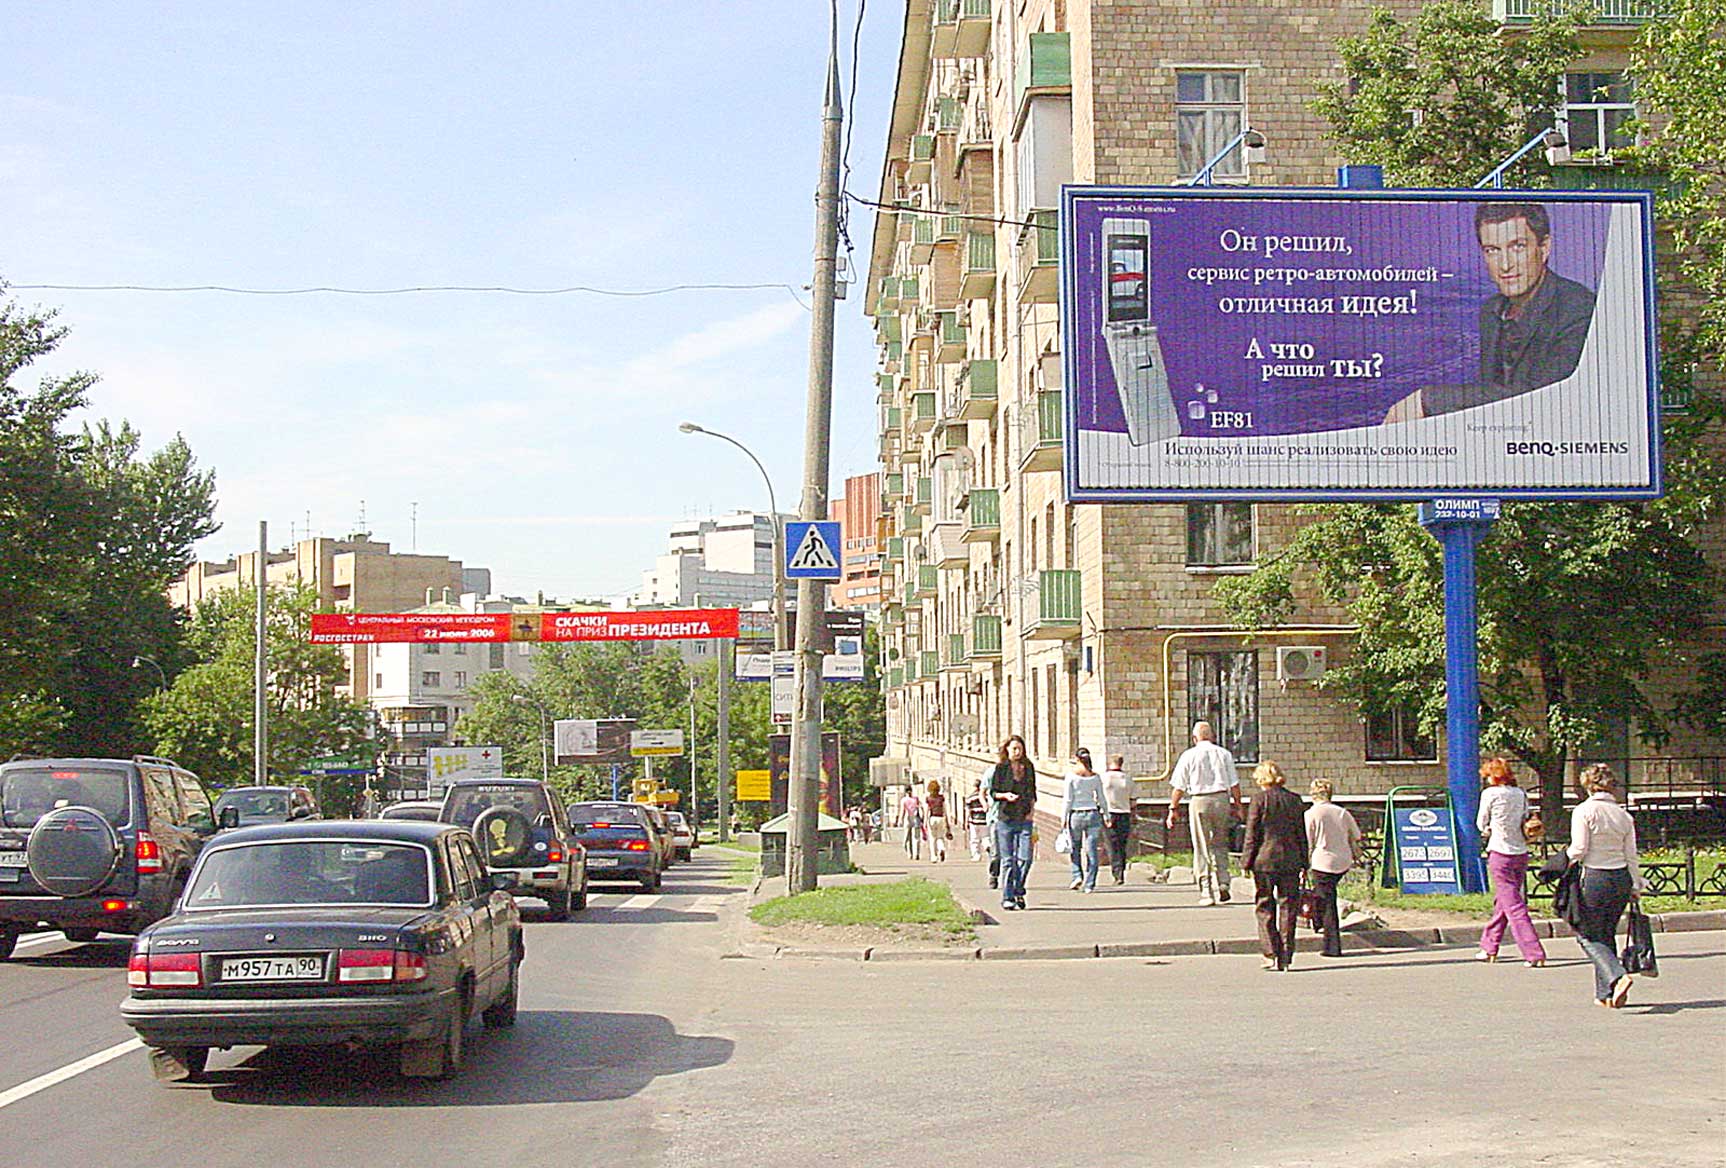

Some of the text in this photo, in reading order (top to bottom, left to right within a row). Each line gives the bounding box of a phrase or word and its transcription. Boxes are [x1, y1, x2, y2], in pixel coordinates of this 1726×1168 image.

[1220, 229, 1353, 258] Он решил,
[1187, 267, 1250, 285] сервис
[1254, 264, 1438, 285] ретро-автомобилей
[1219, 289, 1418, 318] отличная идея!
[1244, 337, 1315, 360] А что
[1261, 364, 1325, 382] решил
[1210, 411, 1253, 429] EF81
[1165, 442, 1458, 459] Используй шанс реализовать свою идею
[1435, 499, 1480, 510] ОЛИМП
[555, 616, 607, 628] СКАЧКИ
[556, 622, 711, 638] НА ПРИЗ ПРЕЗИДЕНТА
[424, 629, 438, 638] 22
[471, 629, 495, 638] 2006
